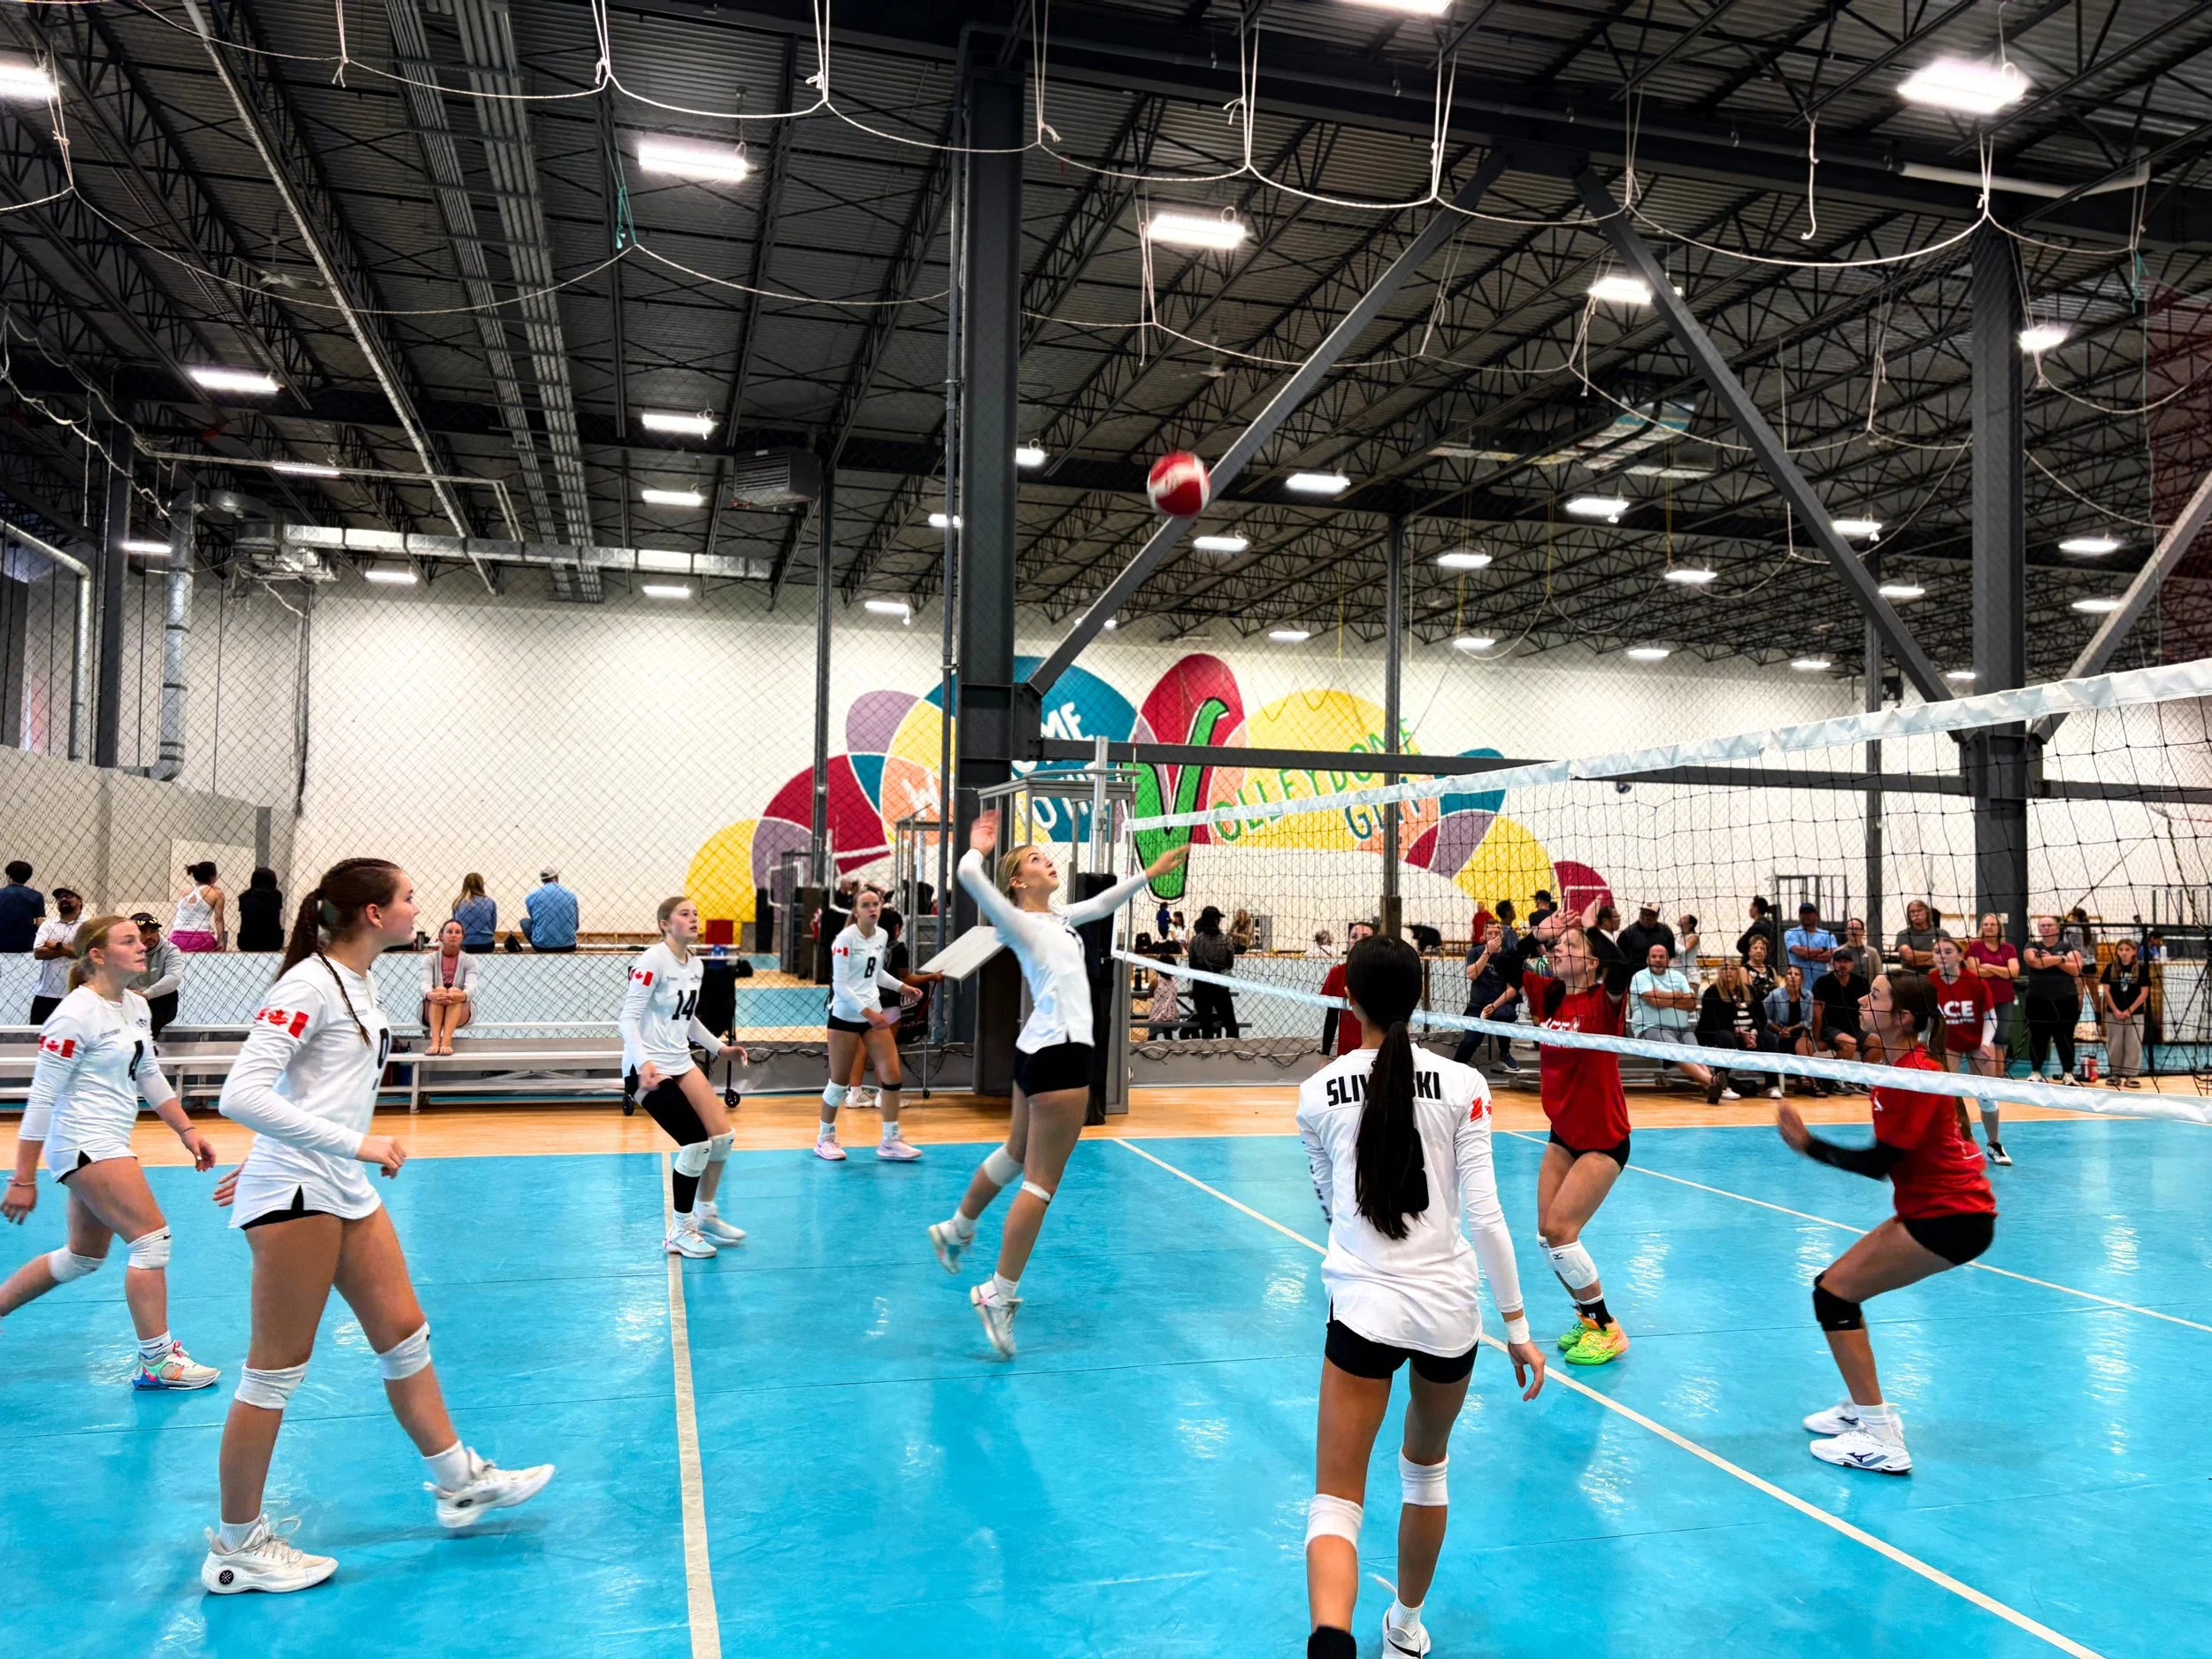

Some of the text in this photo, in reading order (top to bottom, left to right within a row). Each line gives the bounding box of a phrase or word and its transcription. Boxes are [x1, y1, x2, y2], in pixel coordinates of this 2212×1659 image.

[864, 956, 876, 978] 8
[671, 989, 697, 1020] 14
[1937, 1000, 1975, 1018] CE
